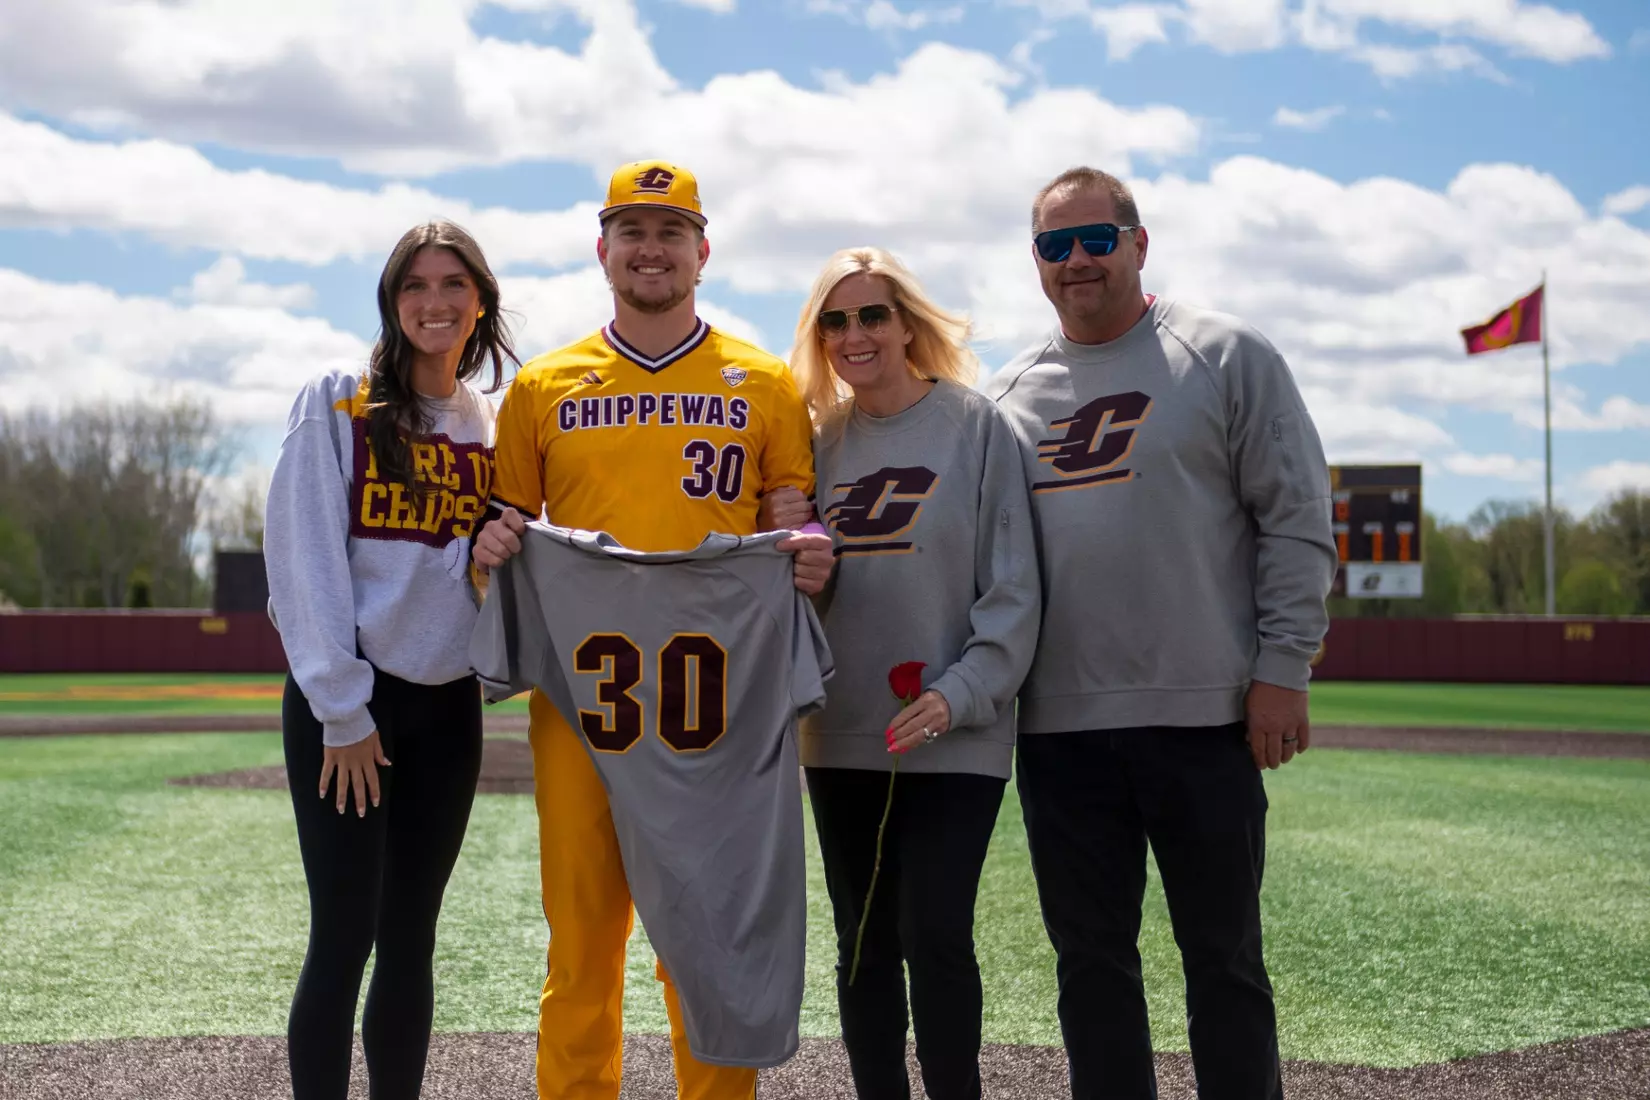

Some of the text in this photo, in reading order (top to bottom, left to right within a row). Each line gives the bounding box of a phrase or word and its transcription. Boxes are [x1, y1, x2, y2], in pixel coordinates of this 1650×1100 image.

[558, 392, 749, 432] CHIPPEWAS
[680, 439, 746, 504] 30
[360, 482, 479, 538] CHIPS
[573, 632, 728, 755] 30
